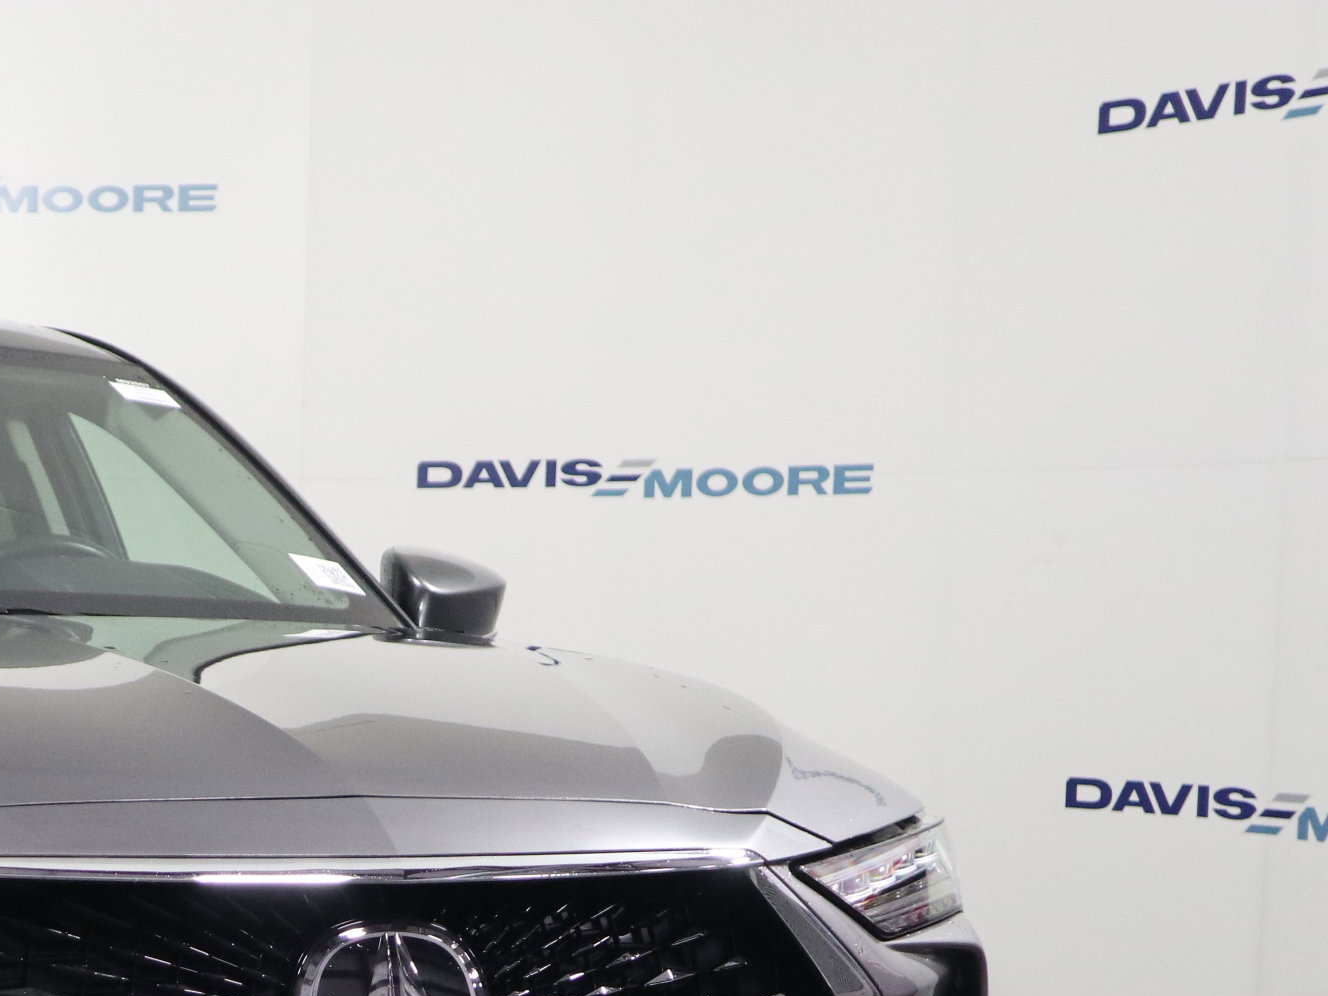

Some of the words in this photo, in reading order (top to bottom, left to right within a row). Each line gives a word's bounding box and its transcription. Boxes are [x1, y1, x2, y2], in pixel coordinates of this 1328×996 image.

[1098, 74, 1296, 135] DAVIS
[417, 458, 603, 488] DAVIS
[643, 463, 874, 498] MOORE
[1065, 776, 1257, 820] DAVIS
